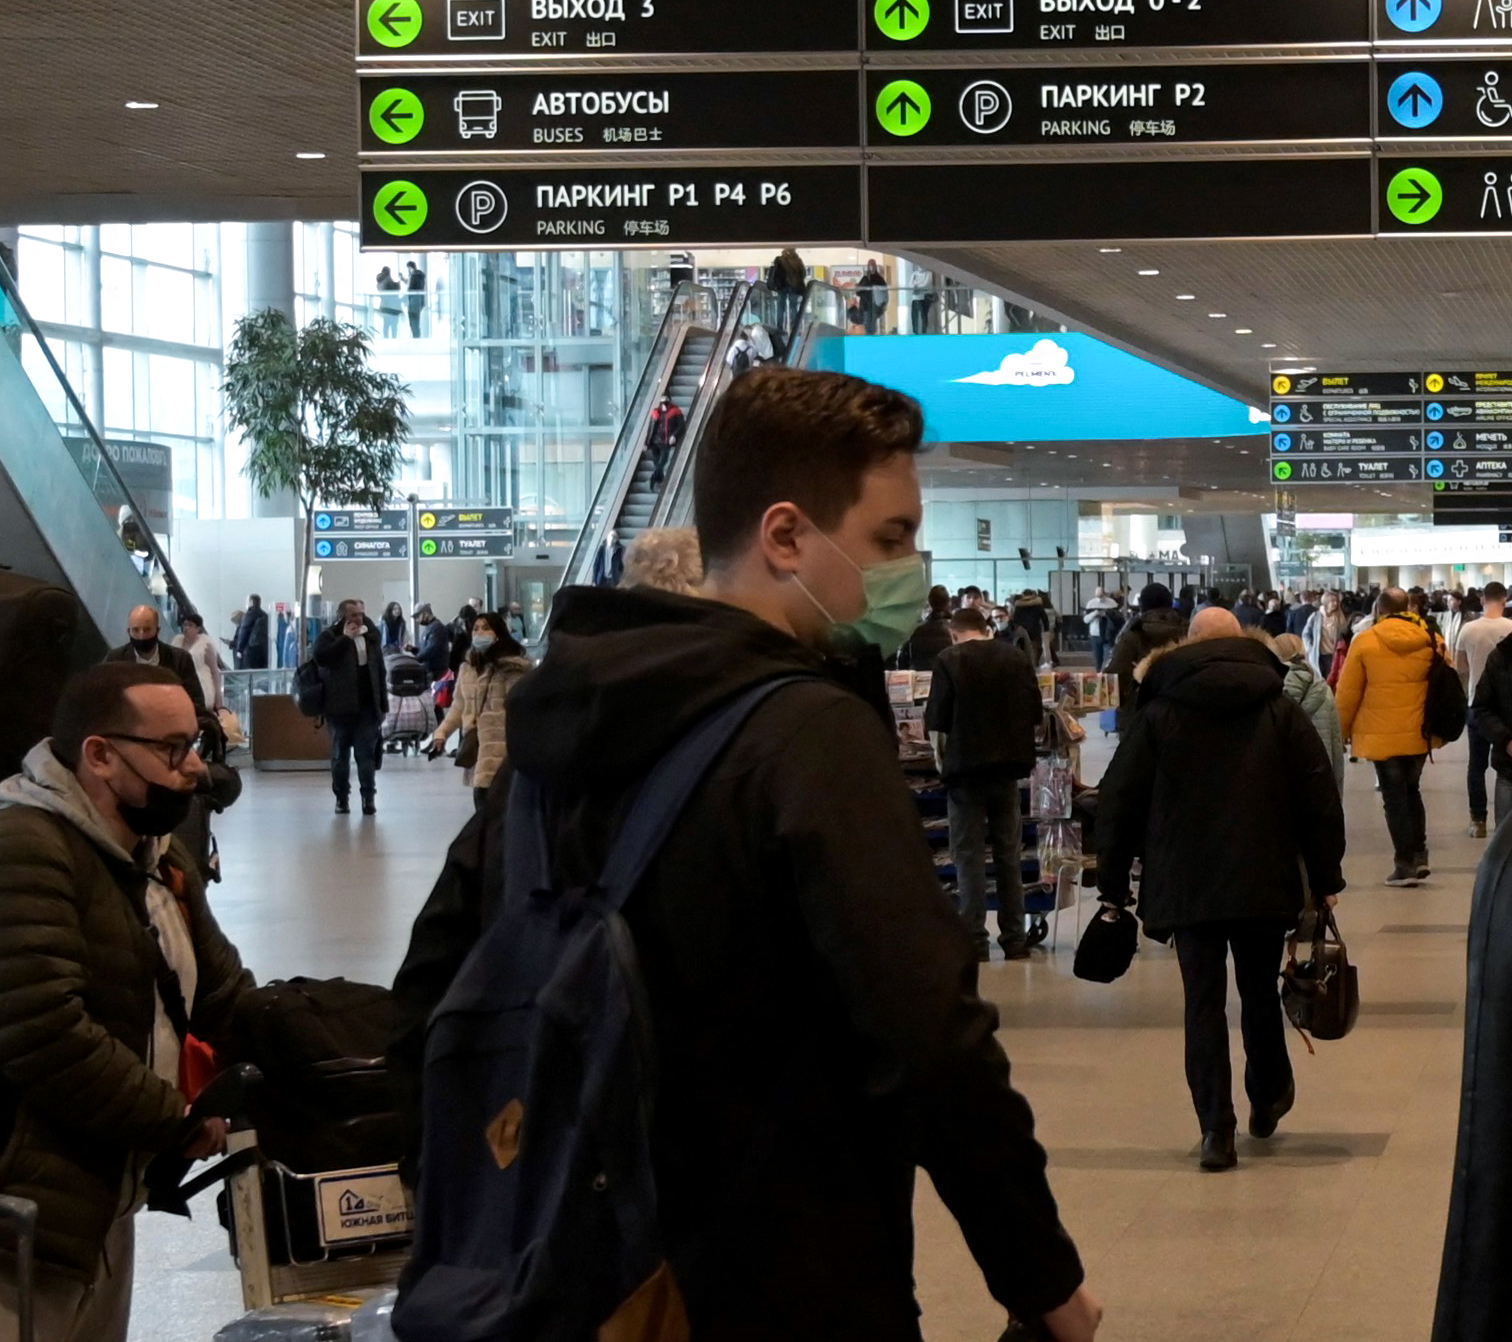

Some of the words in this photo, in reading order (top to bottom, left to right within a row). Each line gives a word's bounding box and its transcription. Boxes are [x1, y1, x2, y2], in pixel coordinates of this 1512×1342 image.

[457, 10, 494, 26] EXIT
[964, 3, 1003, 19] EXIT
[532, 32, 566, 47] EXIT
[586, 32, 616, 47] 出口
[1040, 25, 1075, 40] EXIT
[1095, 26, 1125, 40] 出口
[533, 91, 669, 115] АВТОБУСЫ
[1041, 85, 1160, 108] ПАРКИНГ
[1175, 84, 1205, 106] P2
[534, 128, 583, 142] BUSES
[603, 127, 662, 142] 机场巴士
[1042, 120, 1110, 136] PARKING
[1129, 120, 1175, 136] 停车场
[537, 185, 655, 207] ПАРКИНГ
[669, 185, 698, 206] P1
[715, 184, 745, 205] P4
[760, 183, 792, 204] P6
[537, 221, 605, 235] PARKING
[624, 220, 669, 235] 停车场
[1359, 463, 1388, 471] ТУАЛЕТ
[459, 540, 486, 548] ТУАЛЕТ
[341, 1216, 383, 1228] ЮЖНАЯ
